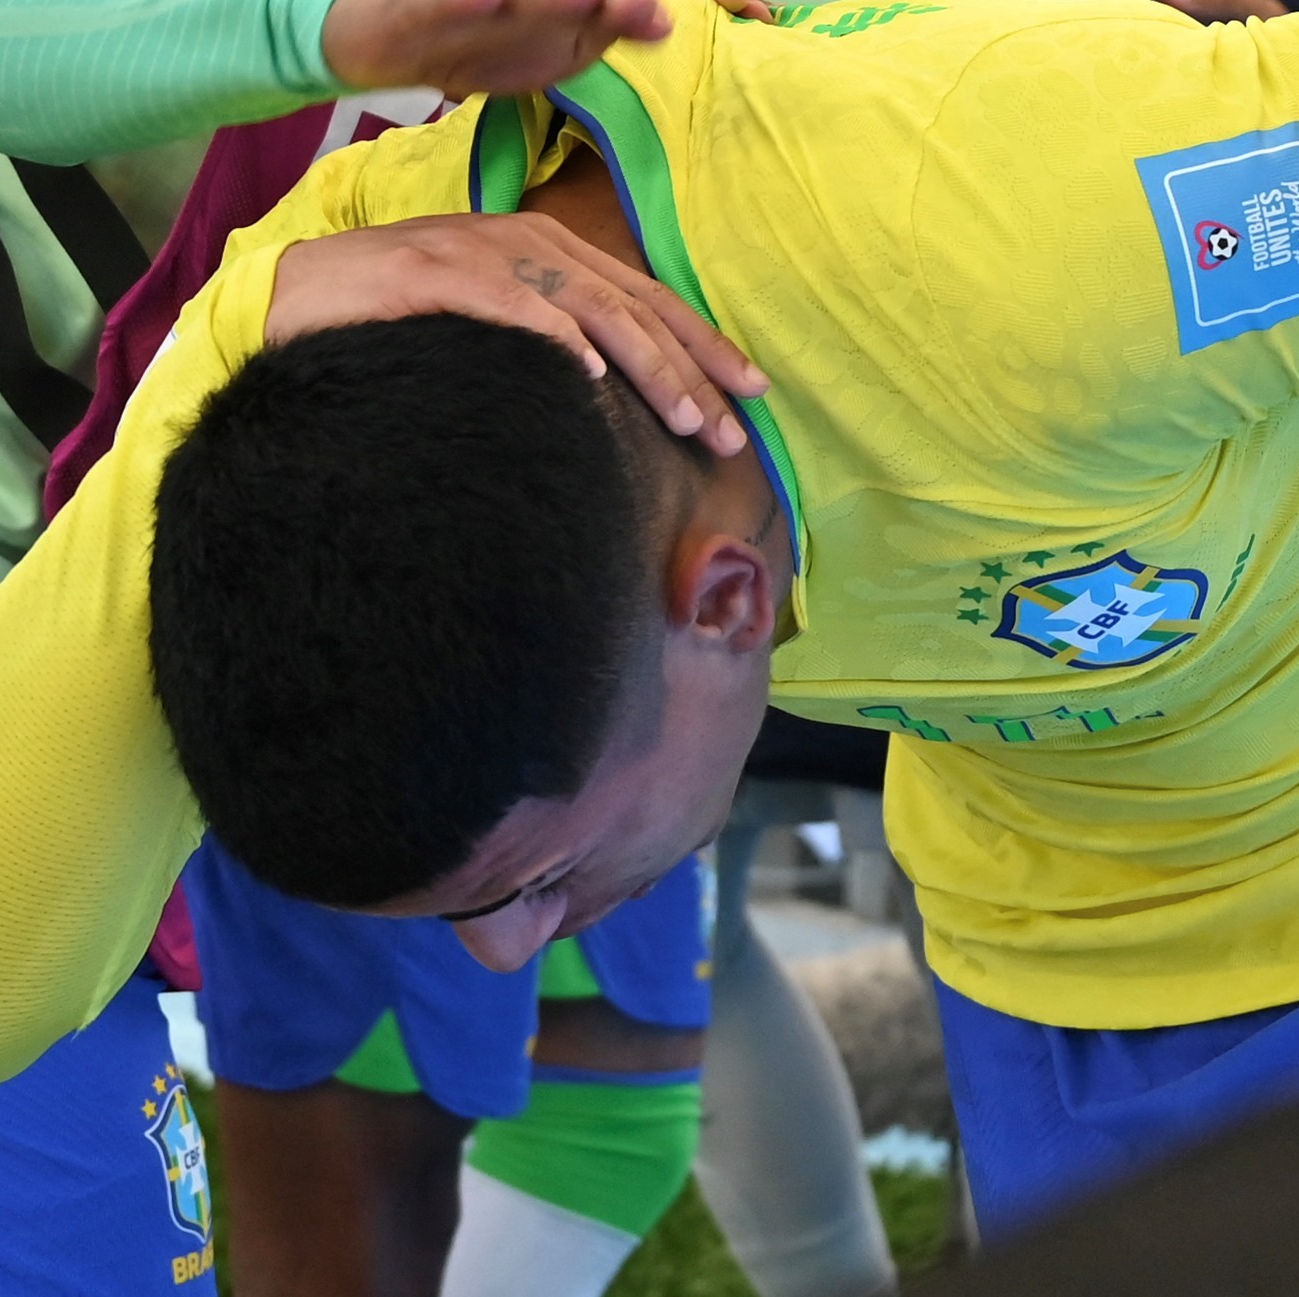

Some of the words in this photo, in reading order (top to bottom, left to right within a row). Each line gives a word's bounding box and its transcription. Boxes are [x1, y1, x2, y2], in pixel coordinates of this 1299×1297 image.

[1242, 194, 1270, 271] FOOTBALL
[1259, 188, 1292, 266] UNITES
[1077, 600, 1129, 639] CBF
